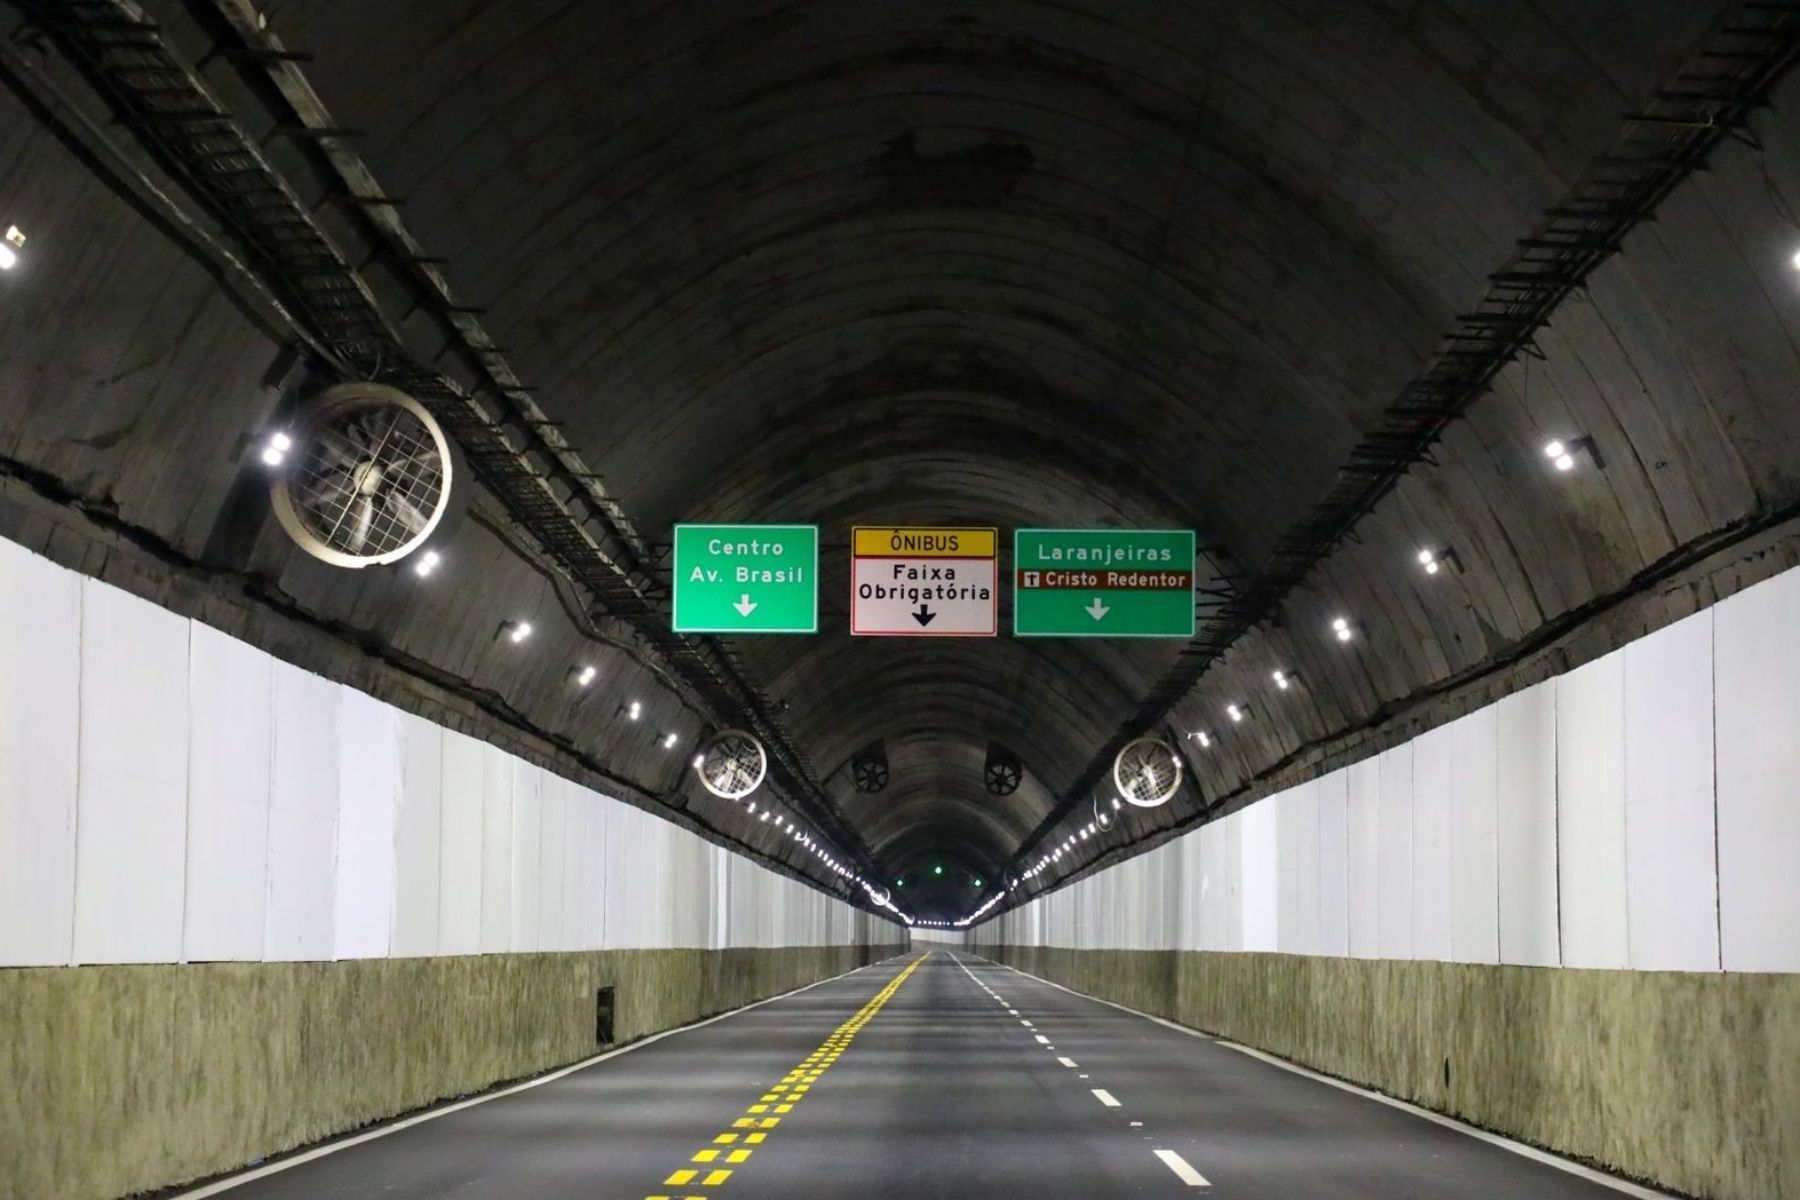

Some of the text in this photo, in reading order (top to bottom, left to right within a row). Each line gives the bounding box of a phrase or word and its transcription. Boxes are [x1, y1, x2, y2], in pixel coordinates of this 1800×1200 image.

[708, 539, 784, 555] Centro
[890, 528, 959, 551] ÔNIBUS
[1038, 544, 1172, 566] Laranjeiras
[689, 566, 803, 583] Av. Brasil
[893, 564, 956, 580] Faixa
[1045, 571, 1187, 587] Cristo Redentor
[858, 583, 990, 604] Obrigatória
